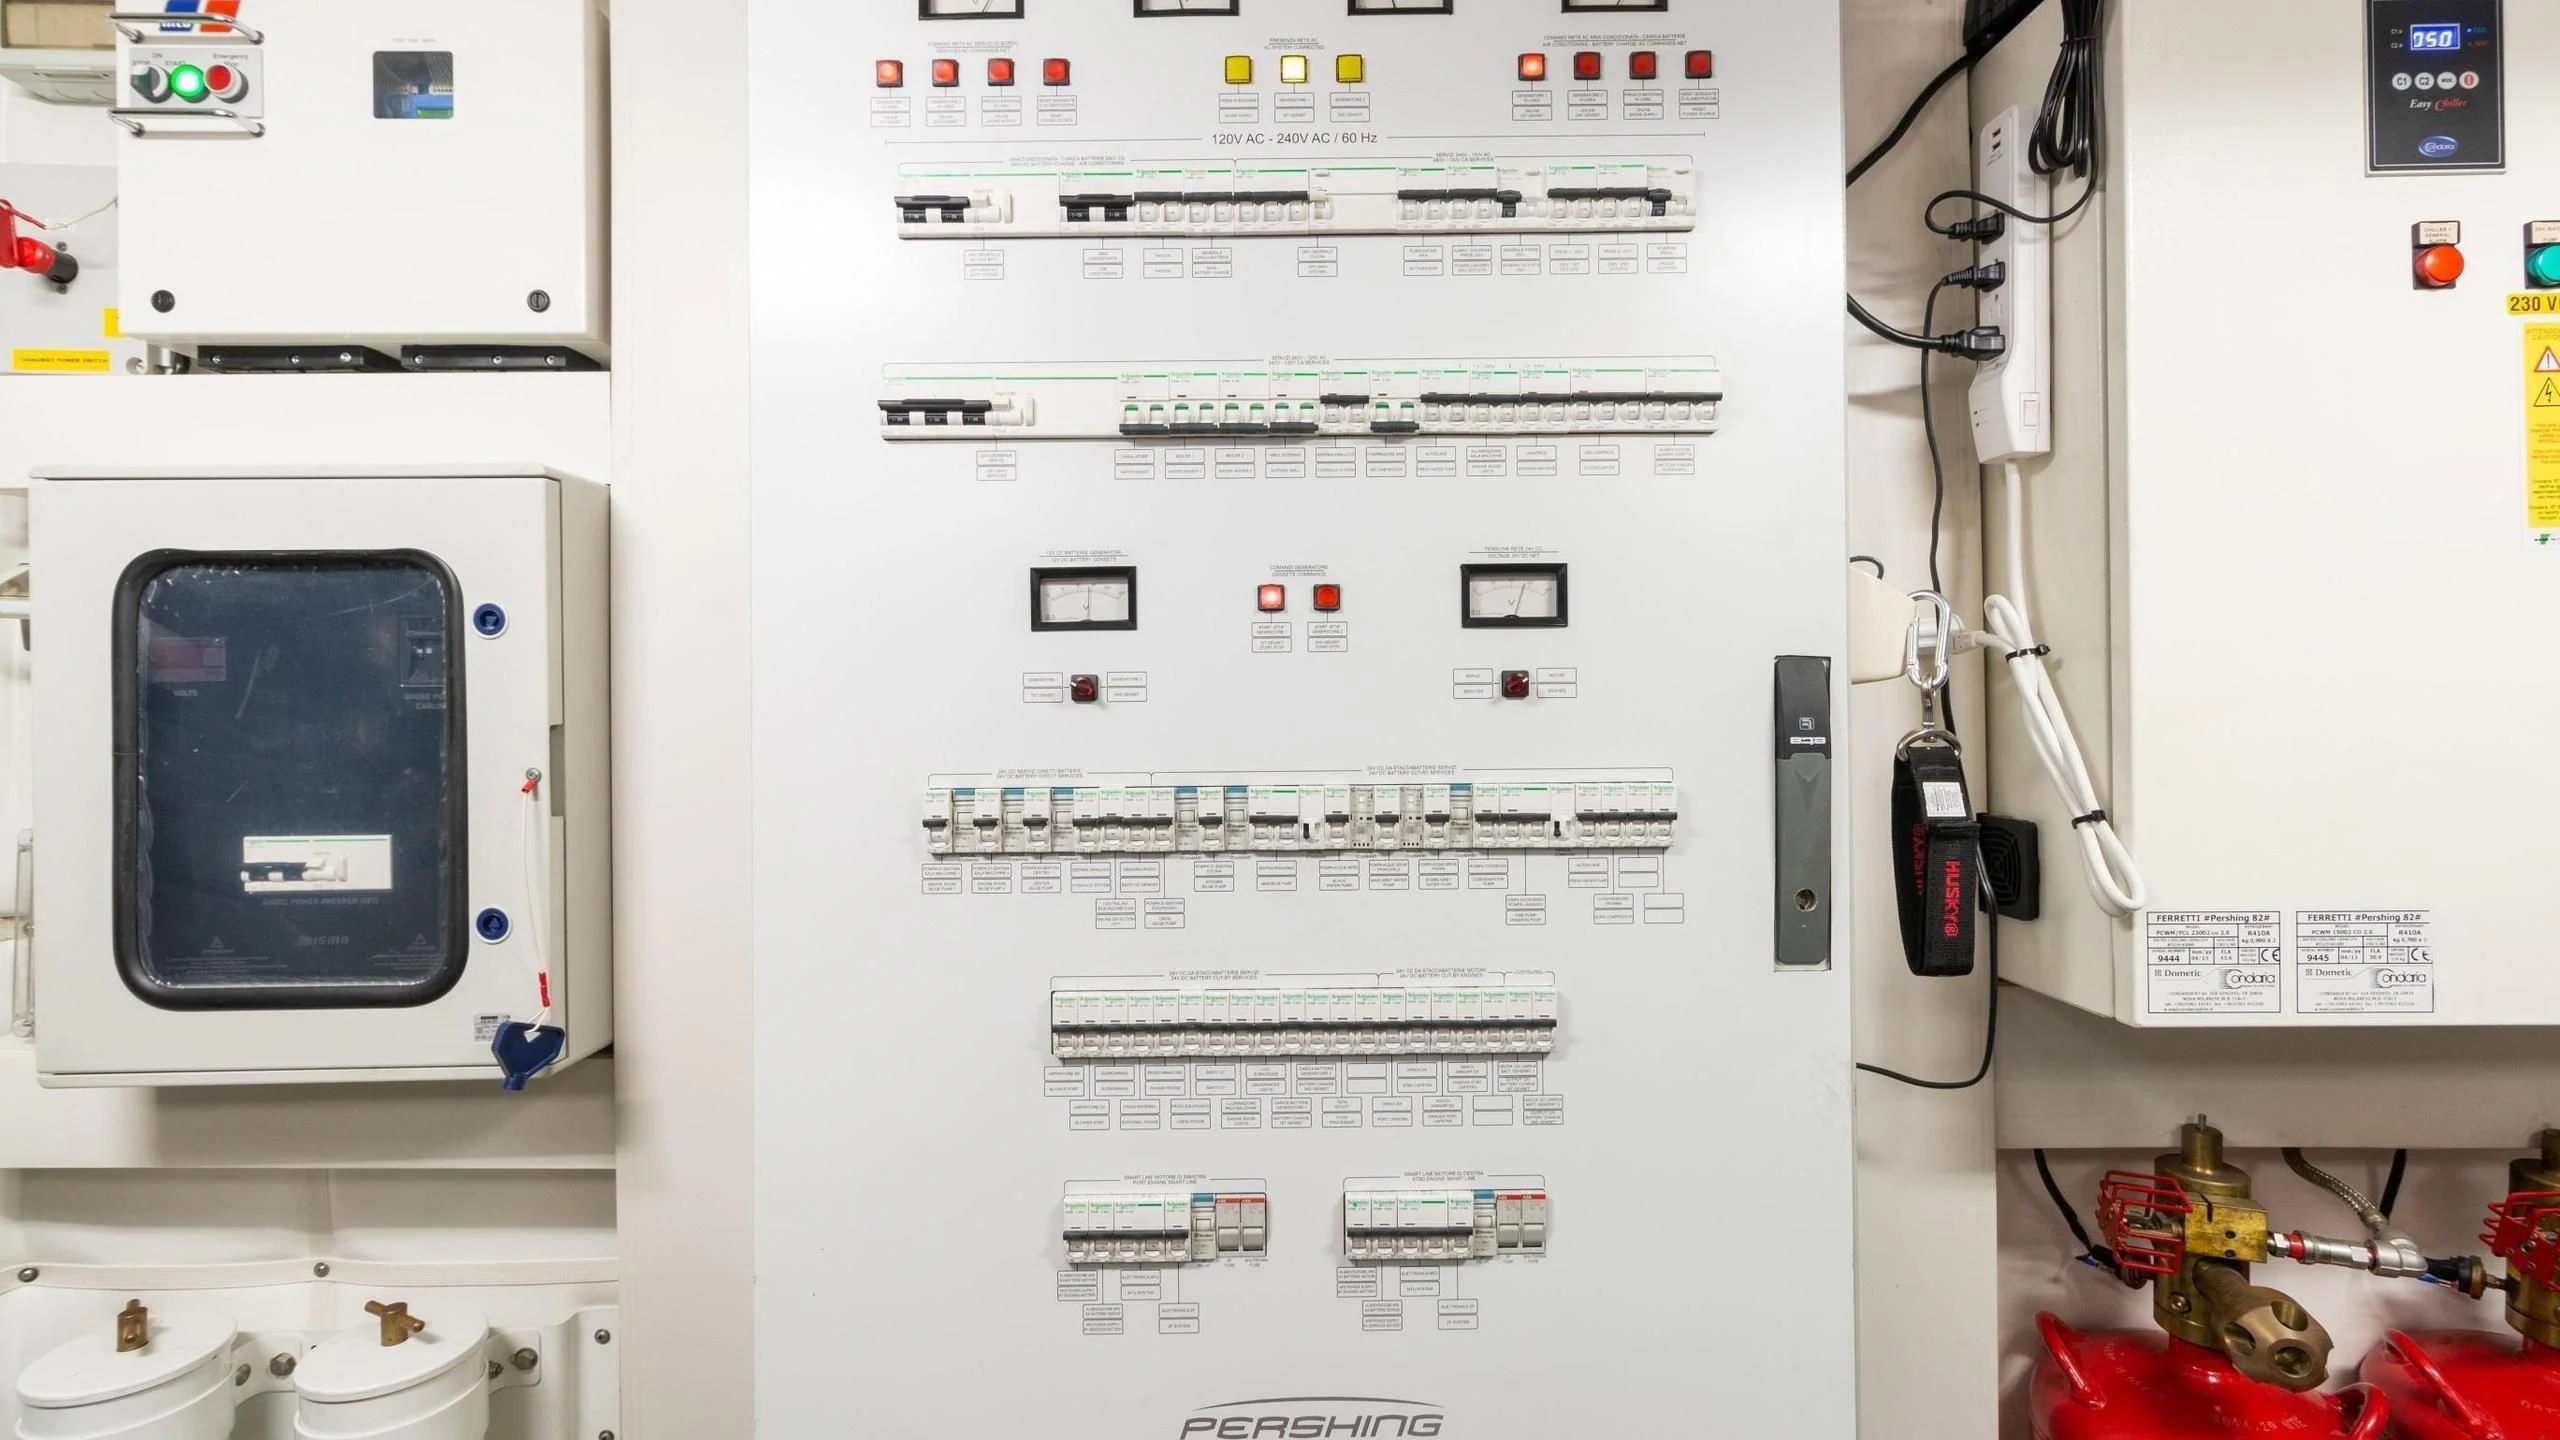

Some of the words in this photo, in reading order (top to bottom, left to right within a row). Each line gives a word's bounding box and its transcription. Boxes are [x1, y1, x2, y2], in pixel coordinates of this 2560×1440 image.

[2396, 78, 2407, 86] C1
[2418, 77, 2430, 86] C2
[2409, 99, 2432, 111] Easy
[1212, 133, 1243, 144] 120V
[1245, 133, 1265, 144] AC
[1276, 132, 1308, 144] 240V
[1311, 132, 1330, 144] AC
[1341, 132, 1357, 144] 60
[1361, 132, 1378, 143] Hz
[2510, 296, 2541, 312] 230
[2547, 296, 2560, 312] V
[2204, 914, 2250, 924] #Pershing
[2355, 914, 2401, 923] #Pershing
[2164, 969, 2201, 977] Dometic
[2315, 968, 2352, 976] Dometic
[2223, 968, 2276, 989] Condaria
[2374, 968, 2426, 989] Condaria
[1180, 1414, 1444, 1440] PERSHING
